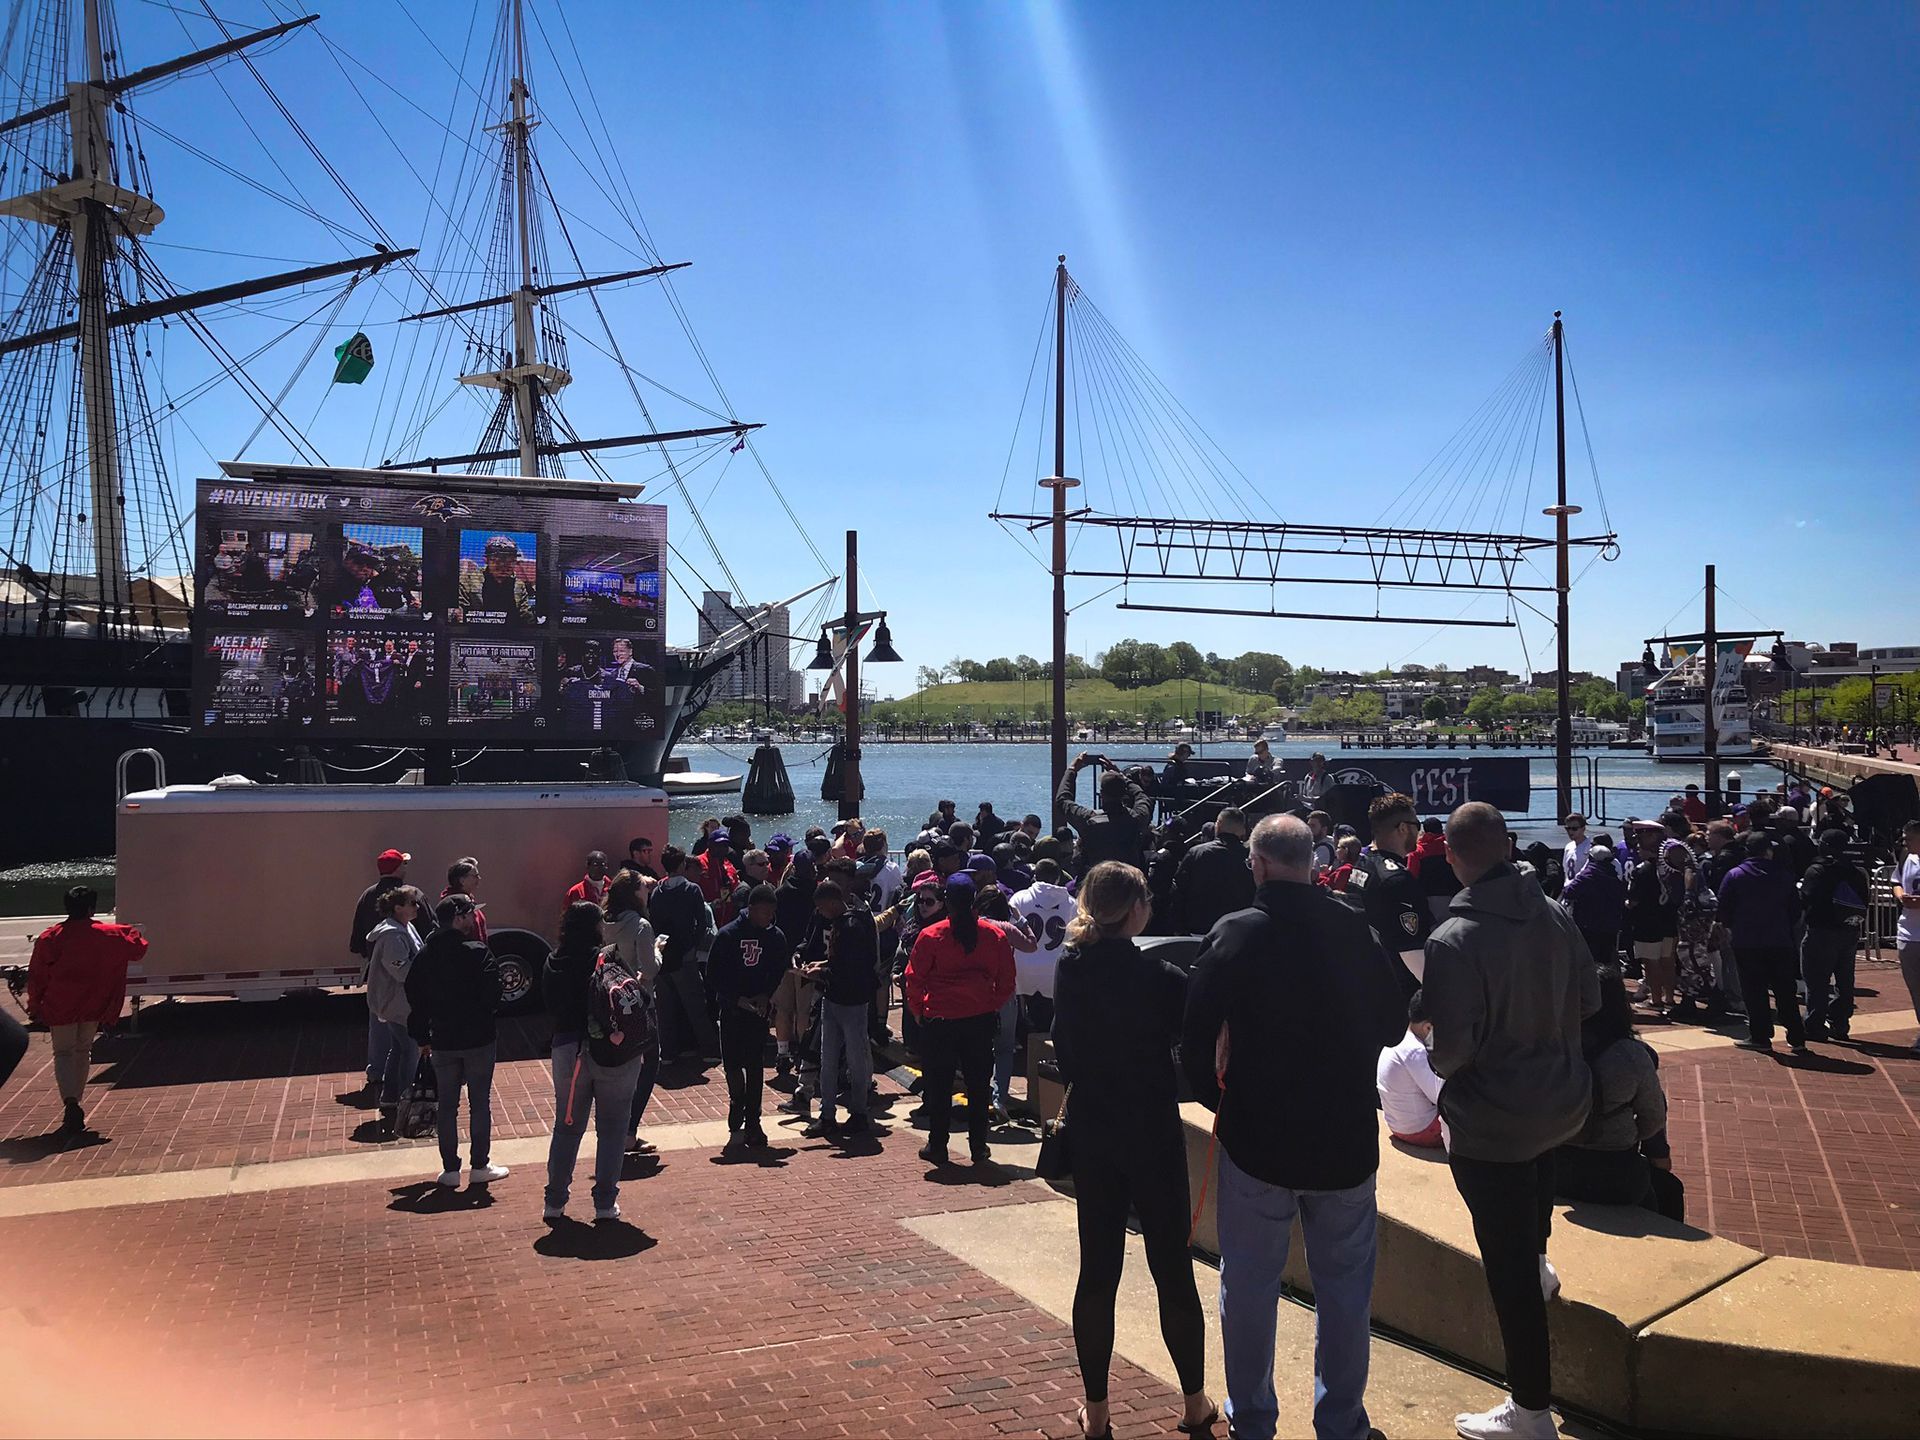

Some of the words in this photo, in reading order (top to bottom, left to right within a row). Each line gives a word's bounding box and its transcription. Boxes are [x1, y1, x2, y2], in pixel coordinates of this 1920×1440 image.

[208, 488, 329, 509] #RAVENSFLOCK
[213, 636, 248, 648] MEET
[250, 636, 270, 649] ME
[219, 648, 264, 661] THERE!
[588, 690, 611, 699] BROWN
[1410, 767, 1472, 807] FEST
